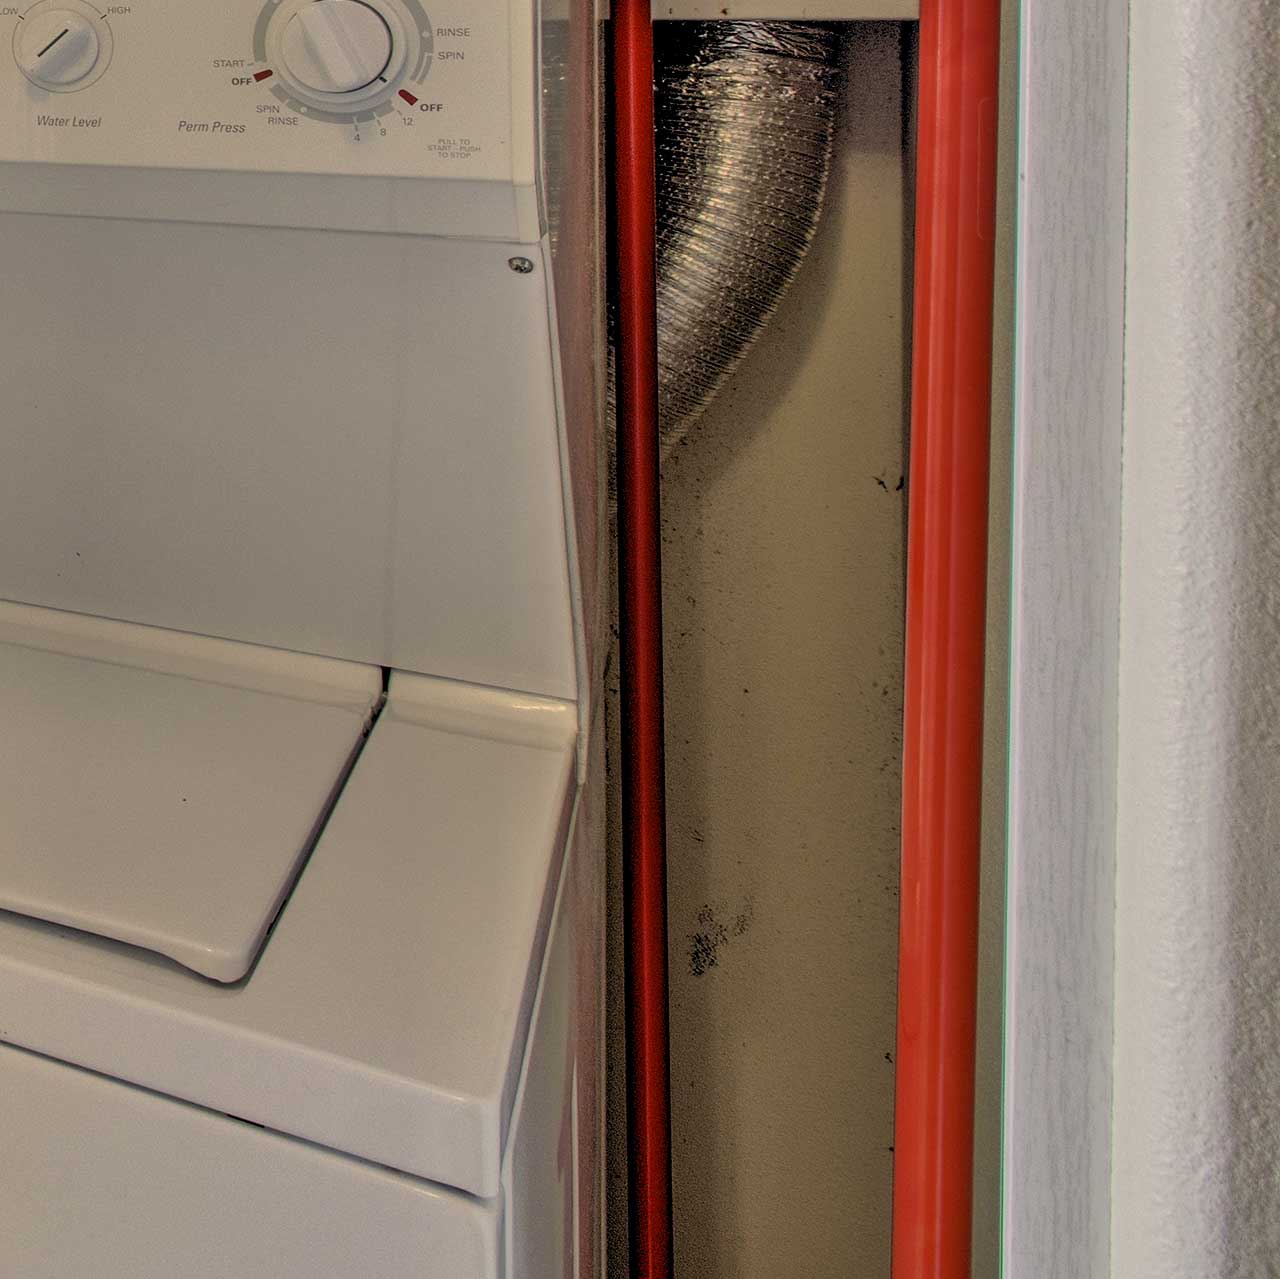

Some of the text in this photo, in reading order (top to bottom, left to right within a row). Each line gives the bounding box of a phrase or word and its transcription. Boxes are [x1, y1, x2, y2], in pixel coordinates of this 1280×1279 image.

[107, 6, 130, 14] HIGH
[437, 28, 470, 37] RINSE
[438, 52, 464, 60] SPIN
[213, 60, 244, 68] START
[256, 105, 280, 113] SPIN
[420, 104, 443, 112] OFF
[37, 115, 101, 127] Water Level
[268, 117, 299, 125] RINSE
[403, 118, 413, 126] 12
[178, 121, 246, 133] Perm Press
[380, 128, 386, 136] 8
